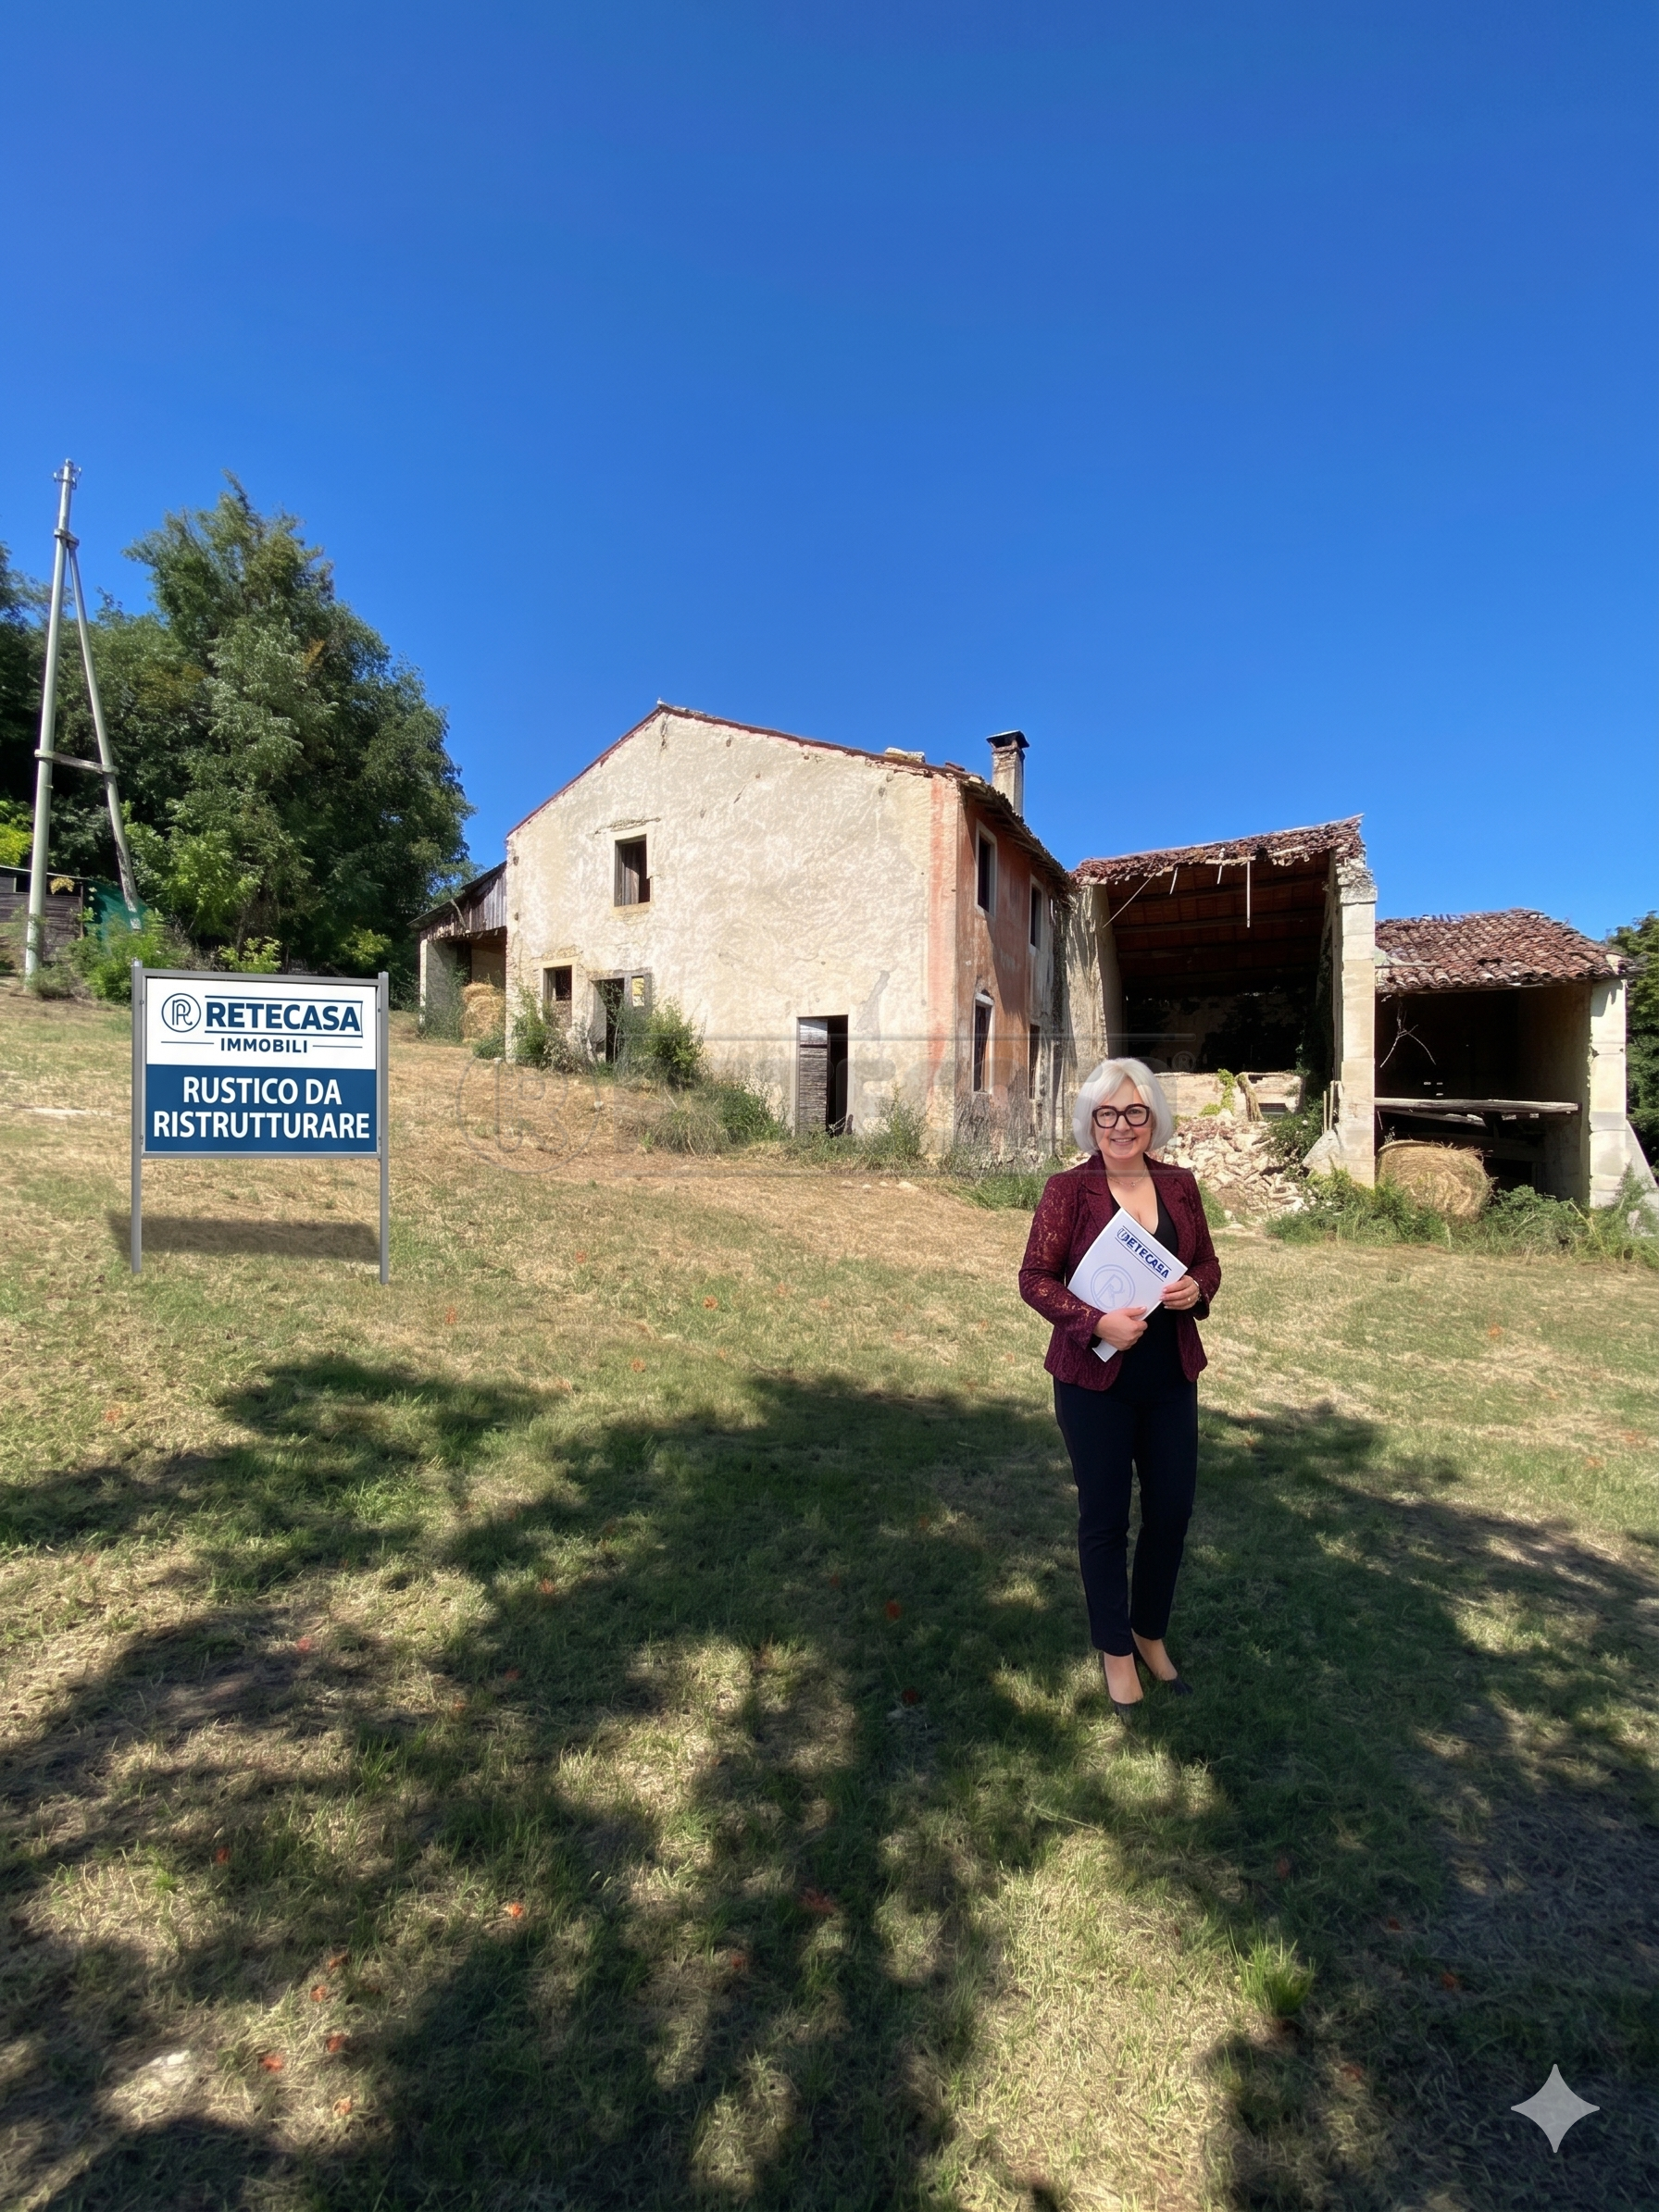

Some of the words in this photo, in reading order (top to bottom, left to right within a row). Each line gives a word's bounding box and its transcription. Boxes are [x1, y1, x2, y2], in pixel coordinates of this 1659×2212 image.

[206, 1001, 362, 1032] RETECASA
[220, 1038, 308, 1053] IMMOBILI
[183, 1076, 298, 1105] RUSTICO
[306, 1078, 343, 1105] DA
[154, 1111, 370, 1139] RISTRUTTURARE
